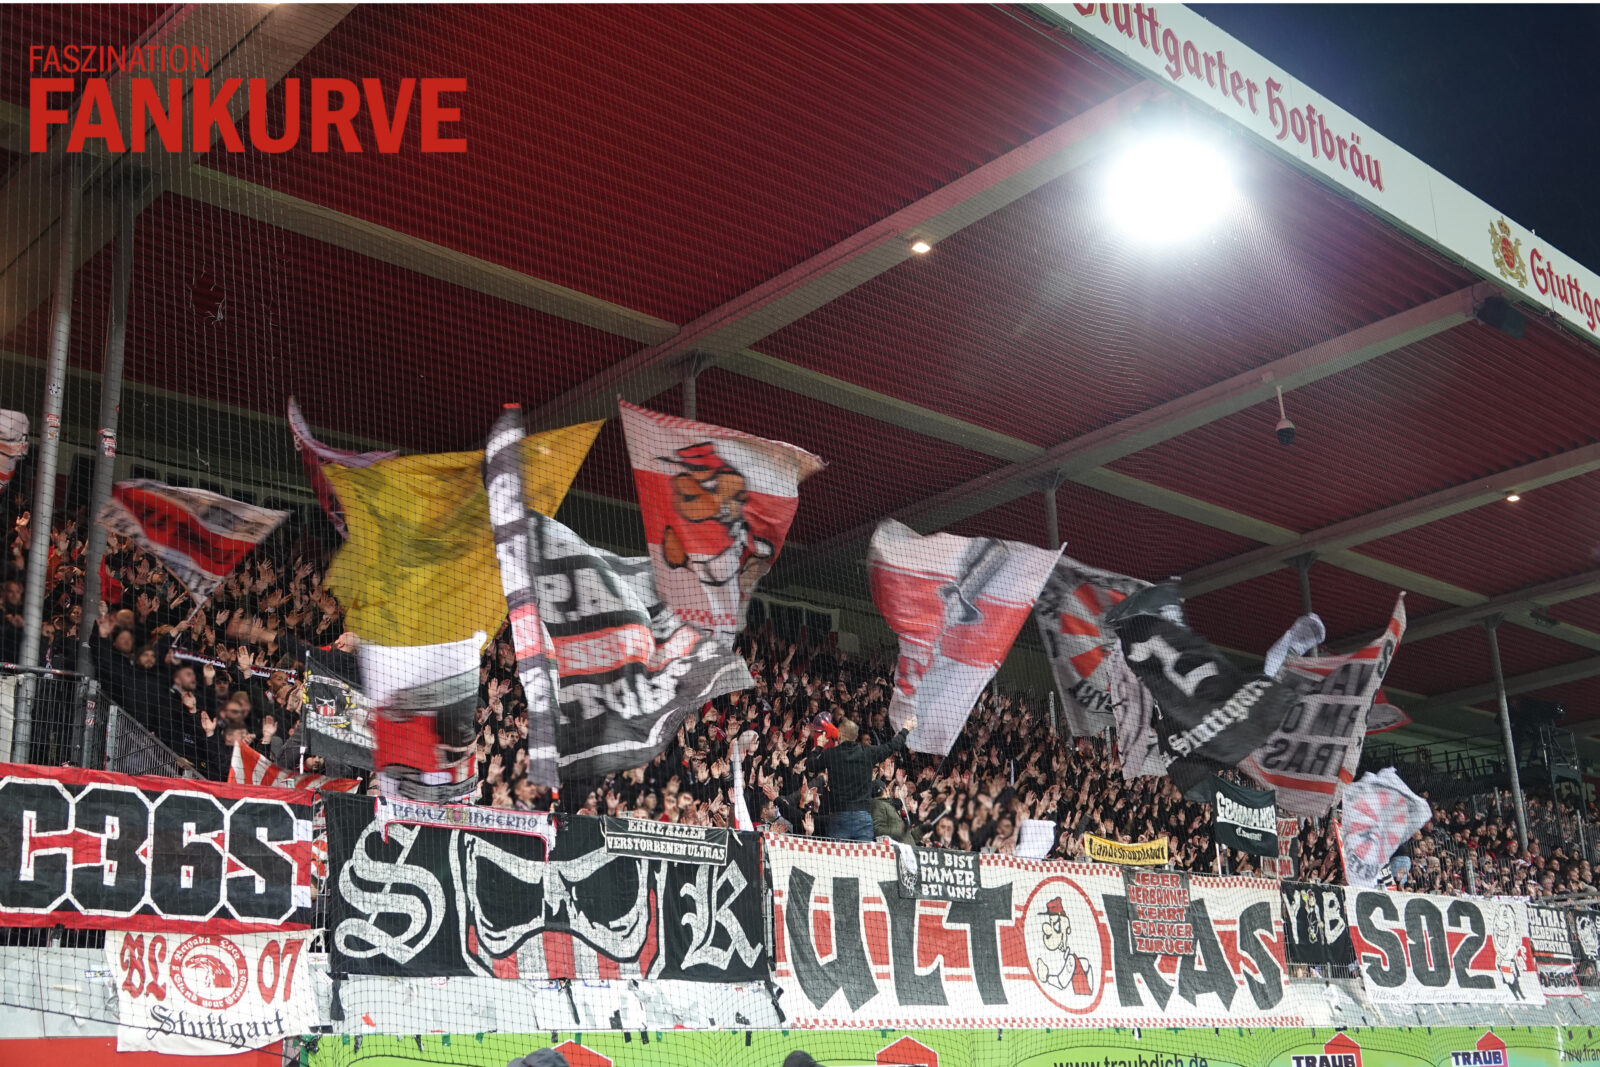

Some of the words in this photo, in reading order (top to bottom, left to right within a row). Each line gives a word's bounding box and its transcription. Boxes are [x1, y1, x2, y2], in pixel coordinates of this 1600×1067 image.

[1265, 76, 1383, 192] Hofbräu
[391, 803, 447, 821] PFALZ
[468, 811, 538, 829] INFERNO
[627, 819, 665, 835] EHRE
[666, 826, 707, 840] ALLEN
[607, 836, 687, 856] VERSTORBENEN
[687, 845, 726, 861] ULTRAS
[919, 851, 939, 866] DU
[944, 853, 974, 869] BIST
[920, 865, 977, 887] IMMER
[1133, 872, 1181, 888] JEDER
[921, 884, 943, 896] BEI
[947, 885, 978, 900] UNS!
[1127, 884, 1190, 906] VERBANNTE
[1136, 905, 1187, 921] KEHRT
[1527, 908, 1567, 929] ULTRAS
[257, 938, 305, 1004] 07
[146, 1004, 286, 1048] Stuttgart
[1292, 1055, 1356, 1067] TRAUB
[1451, 1051, 1503, 1066] TRAUB
